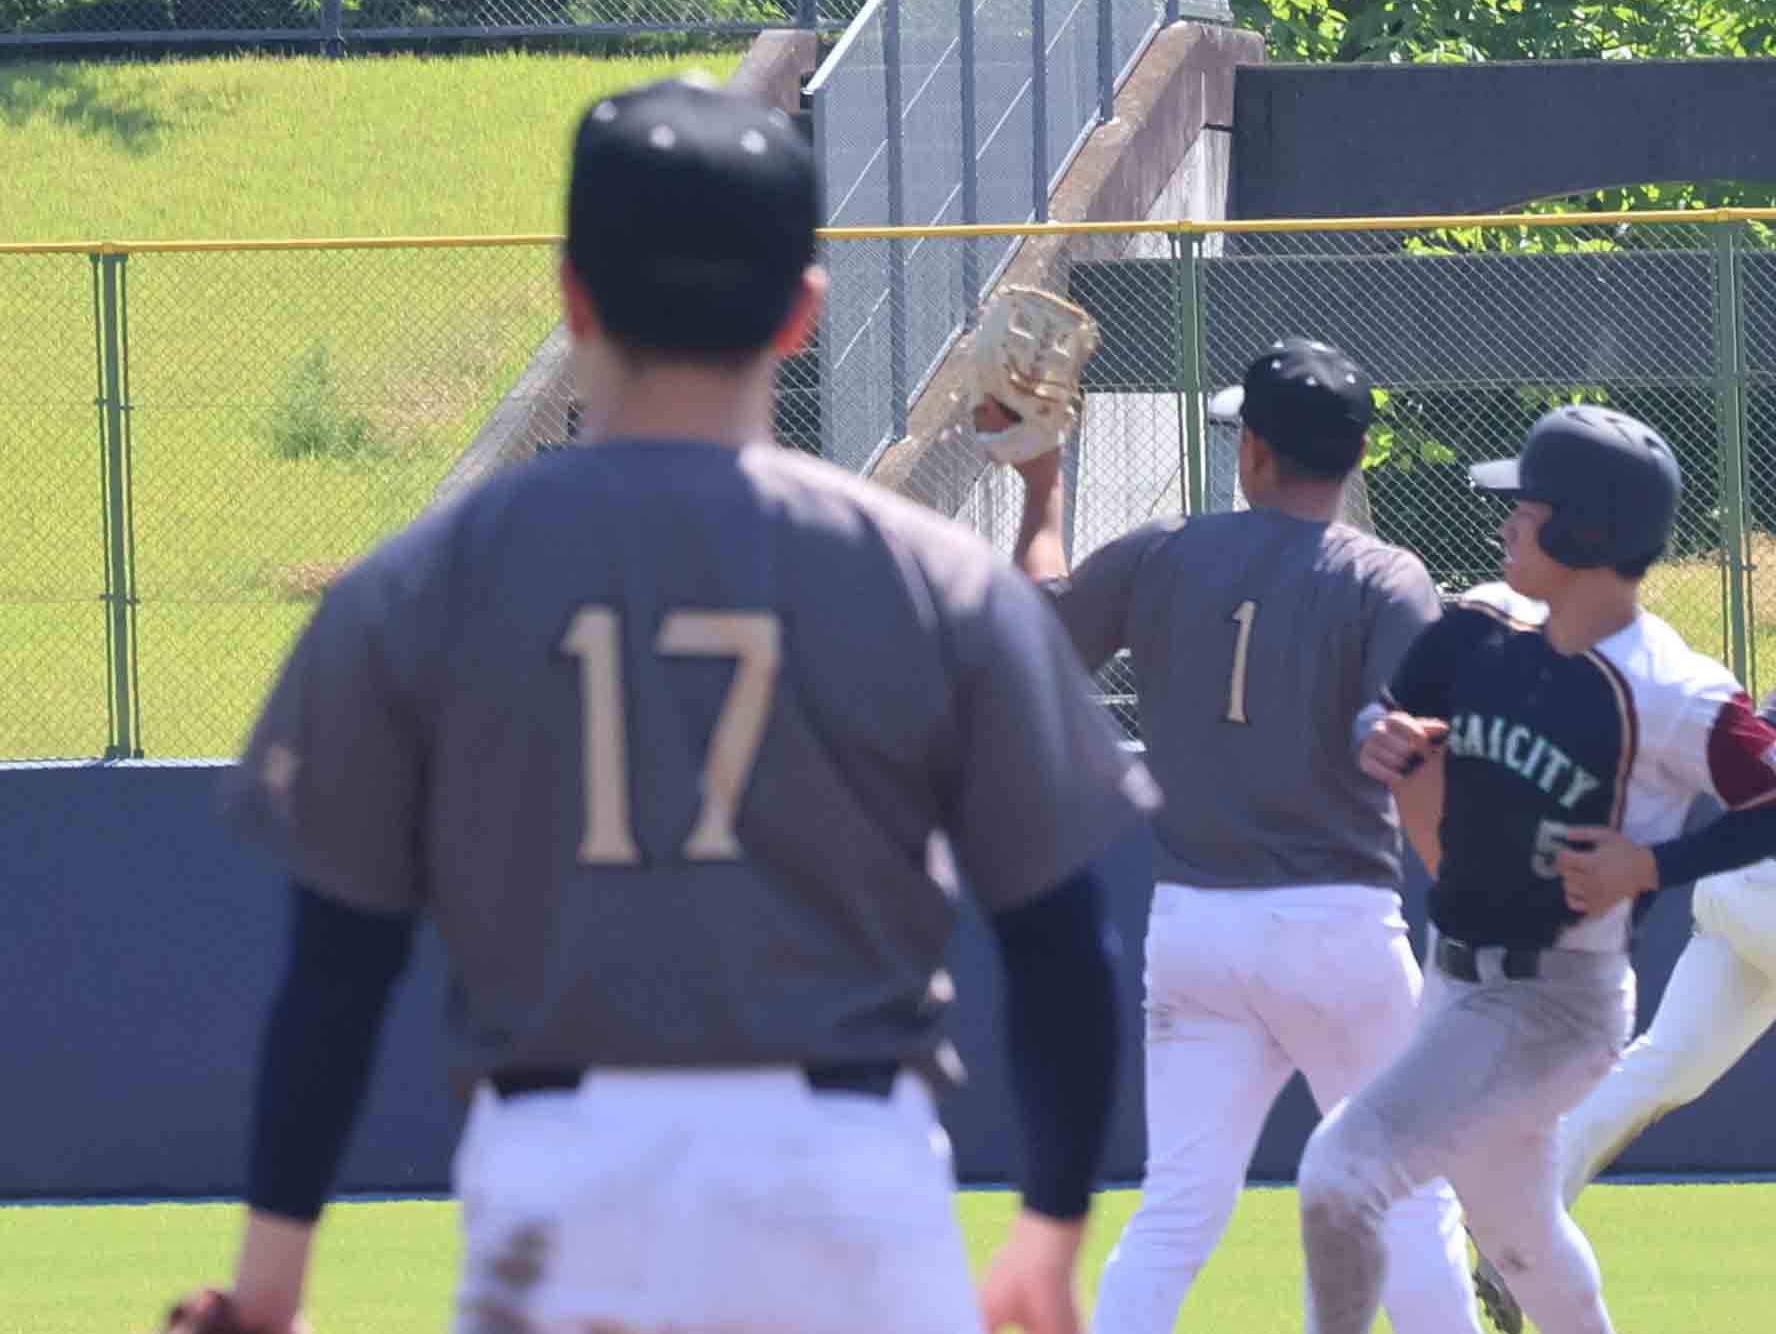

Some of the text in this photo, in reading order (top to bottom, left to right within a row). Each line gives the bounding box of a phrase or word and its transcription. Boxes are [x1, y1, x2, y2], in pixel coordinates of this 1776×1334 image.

[1226, 599, 1257, 724] 1
[559, 603, 782, 864] 17
[1531, 819, 1570, 880] 5
